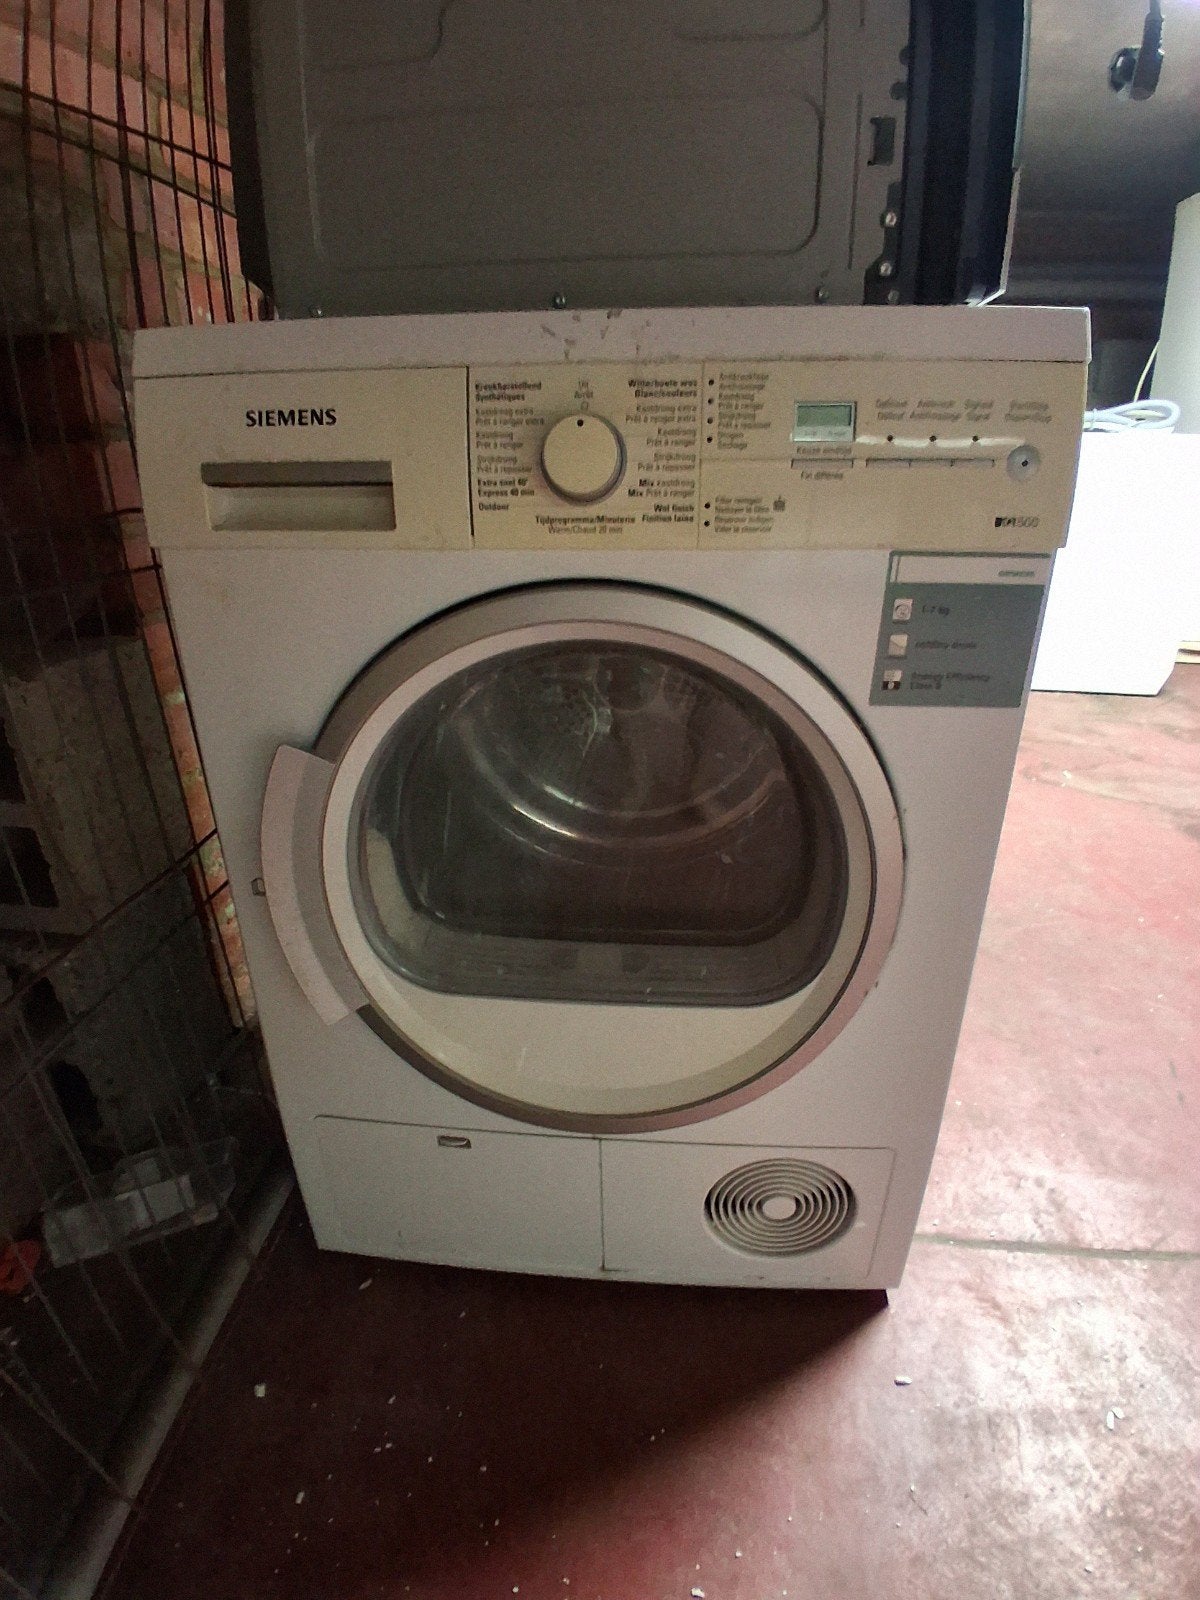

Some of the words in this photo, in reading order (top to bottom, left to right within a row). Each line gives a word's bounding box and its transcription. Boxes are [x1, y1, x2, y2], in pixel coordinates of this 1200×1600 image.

[245, 408, 336, 427] SIEMENS
[638, 478, 654, 487] Mix
[478, 488, 508, 497] Express
[628, 489, 643, 498] Mix
[479, 502, 509, 511] Outdoor
